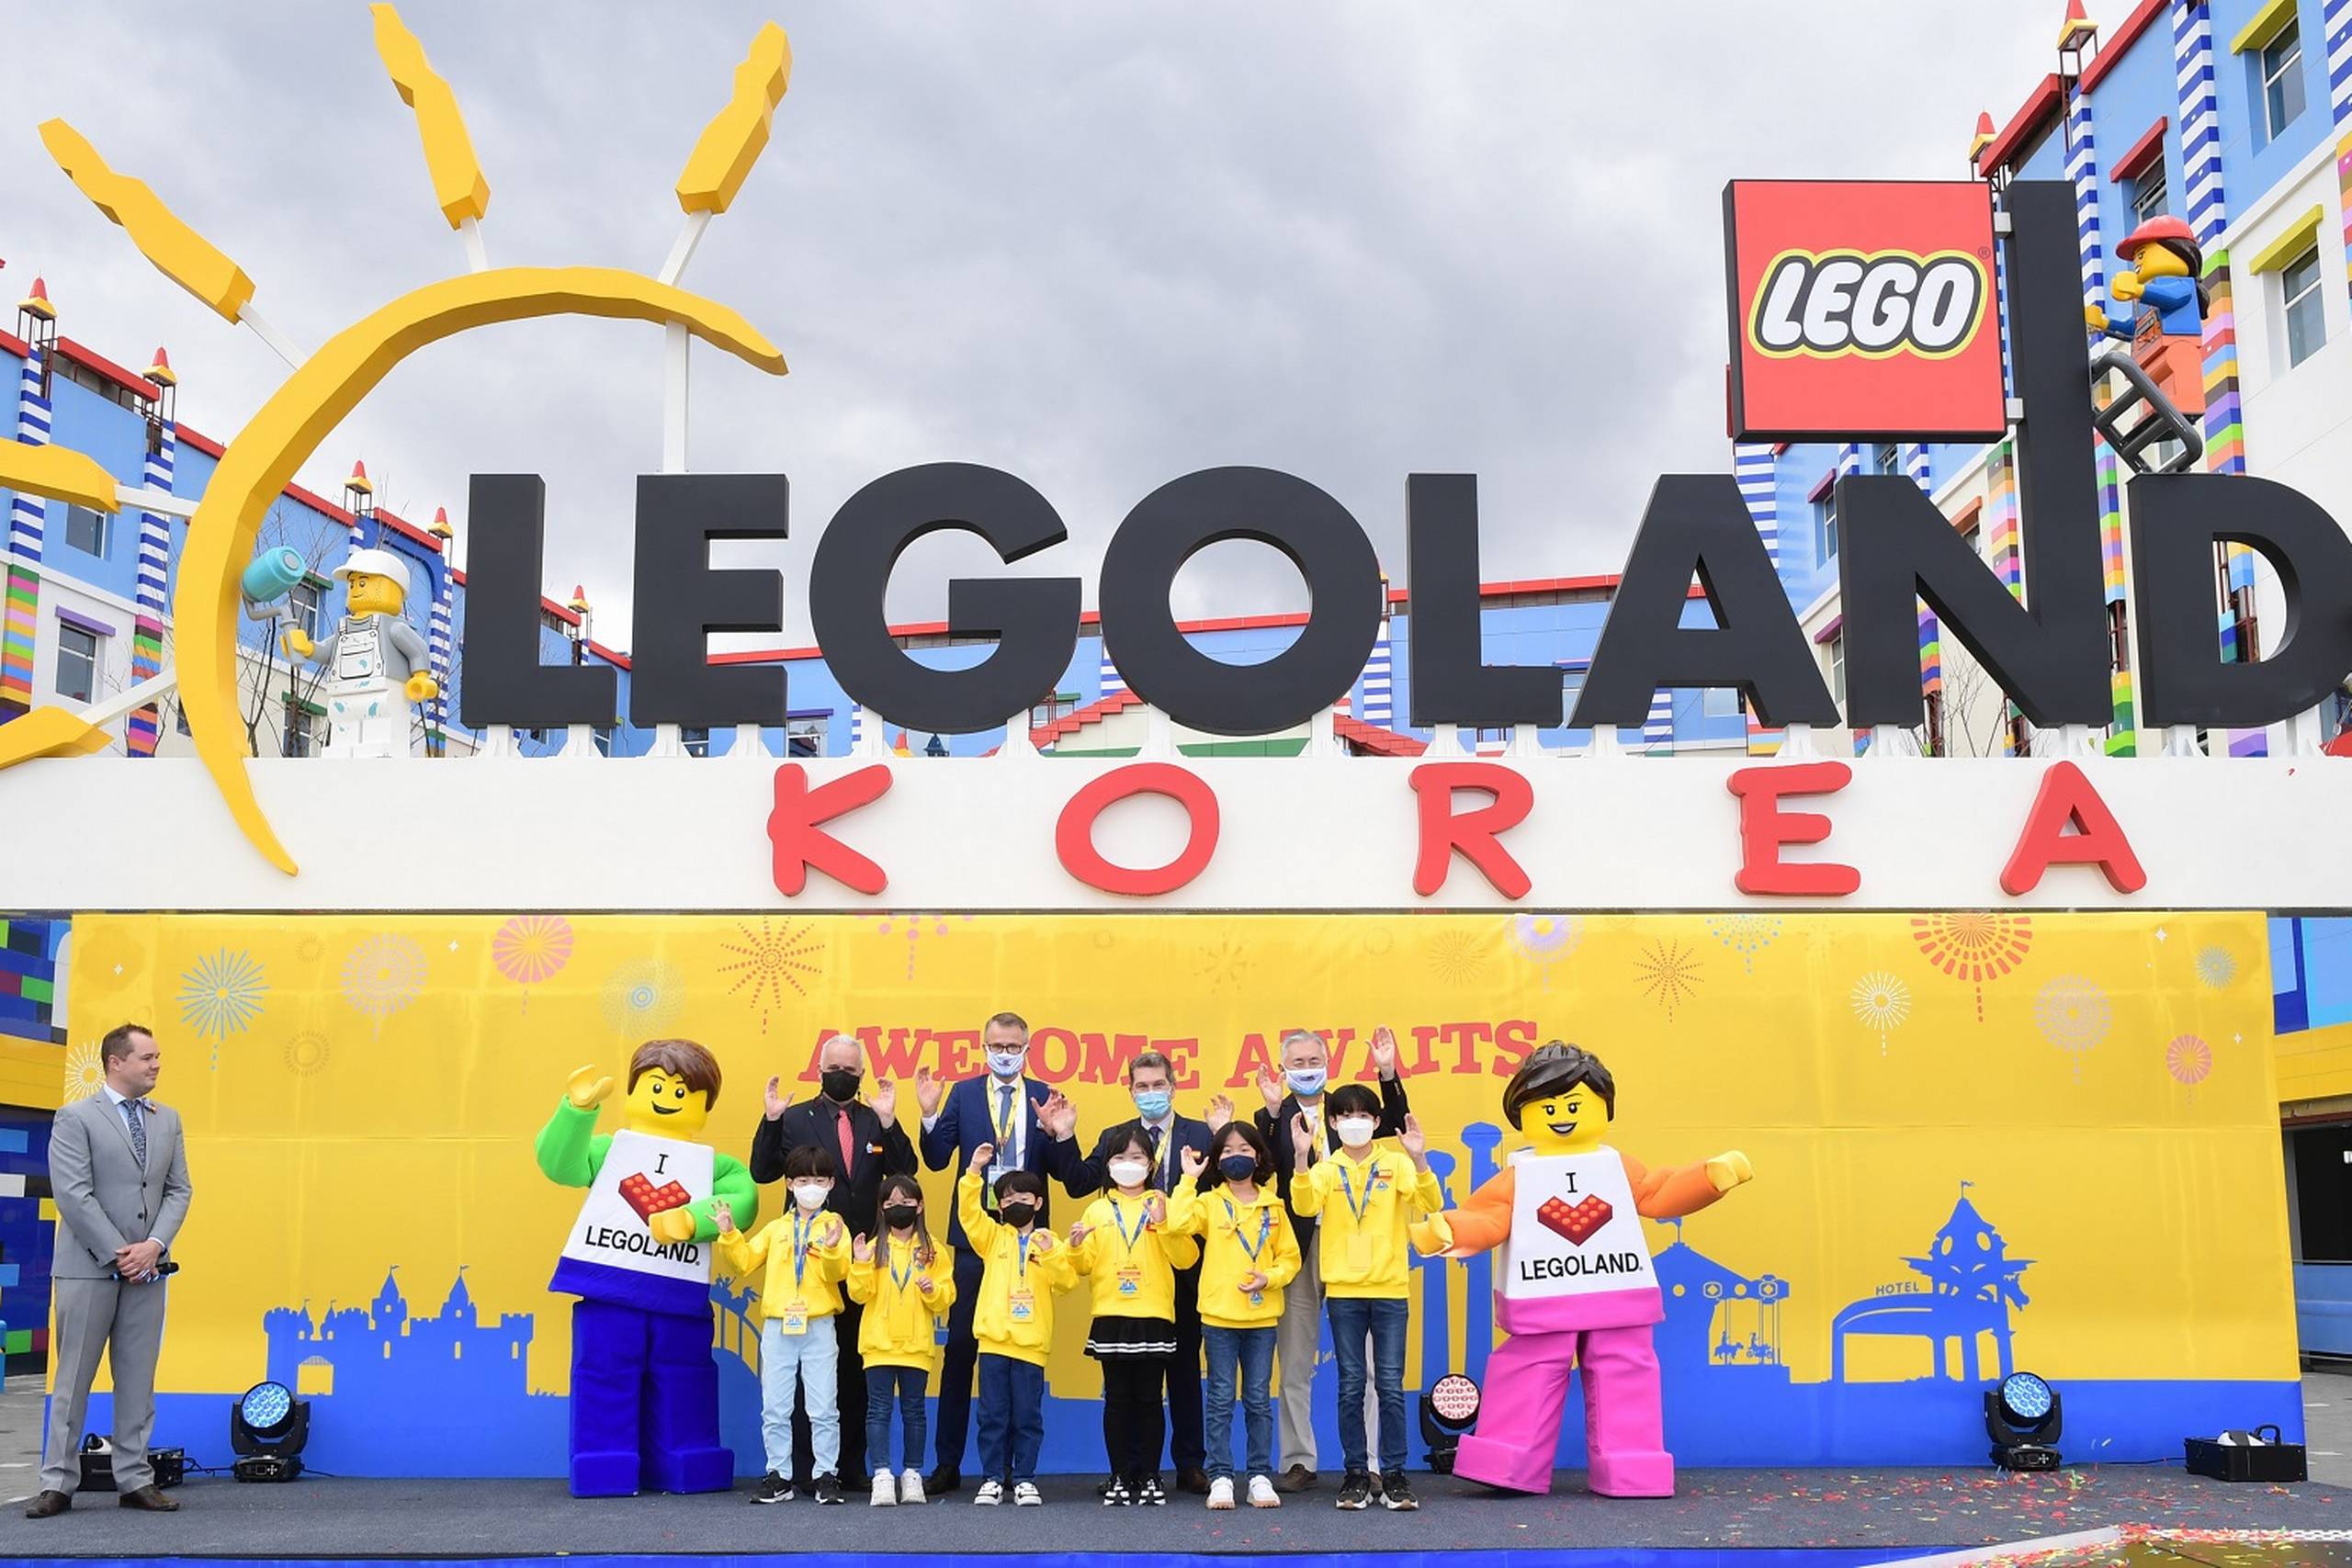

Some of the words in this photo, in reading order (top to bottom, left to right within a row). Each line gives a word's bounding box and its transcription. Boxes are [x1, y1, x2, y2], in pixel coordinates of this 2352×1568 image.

[1758, 258, 1978, 350] LEGO
[461, 179, 2352, 736] LEGOLAND
[767, 761, 2147, 899] KOREA
[797, 1026, 1200, 1089] WEOME
[654, 1153, 669, 1175] I
[1566, 1171, 1578, 1193] I
[1875, 1281, 1919, 1295] HOTEL
